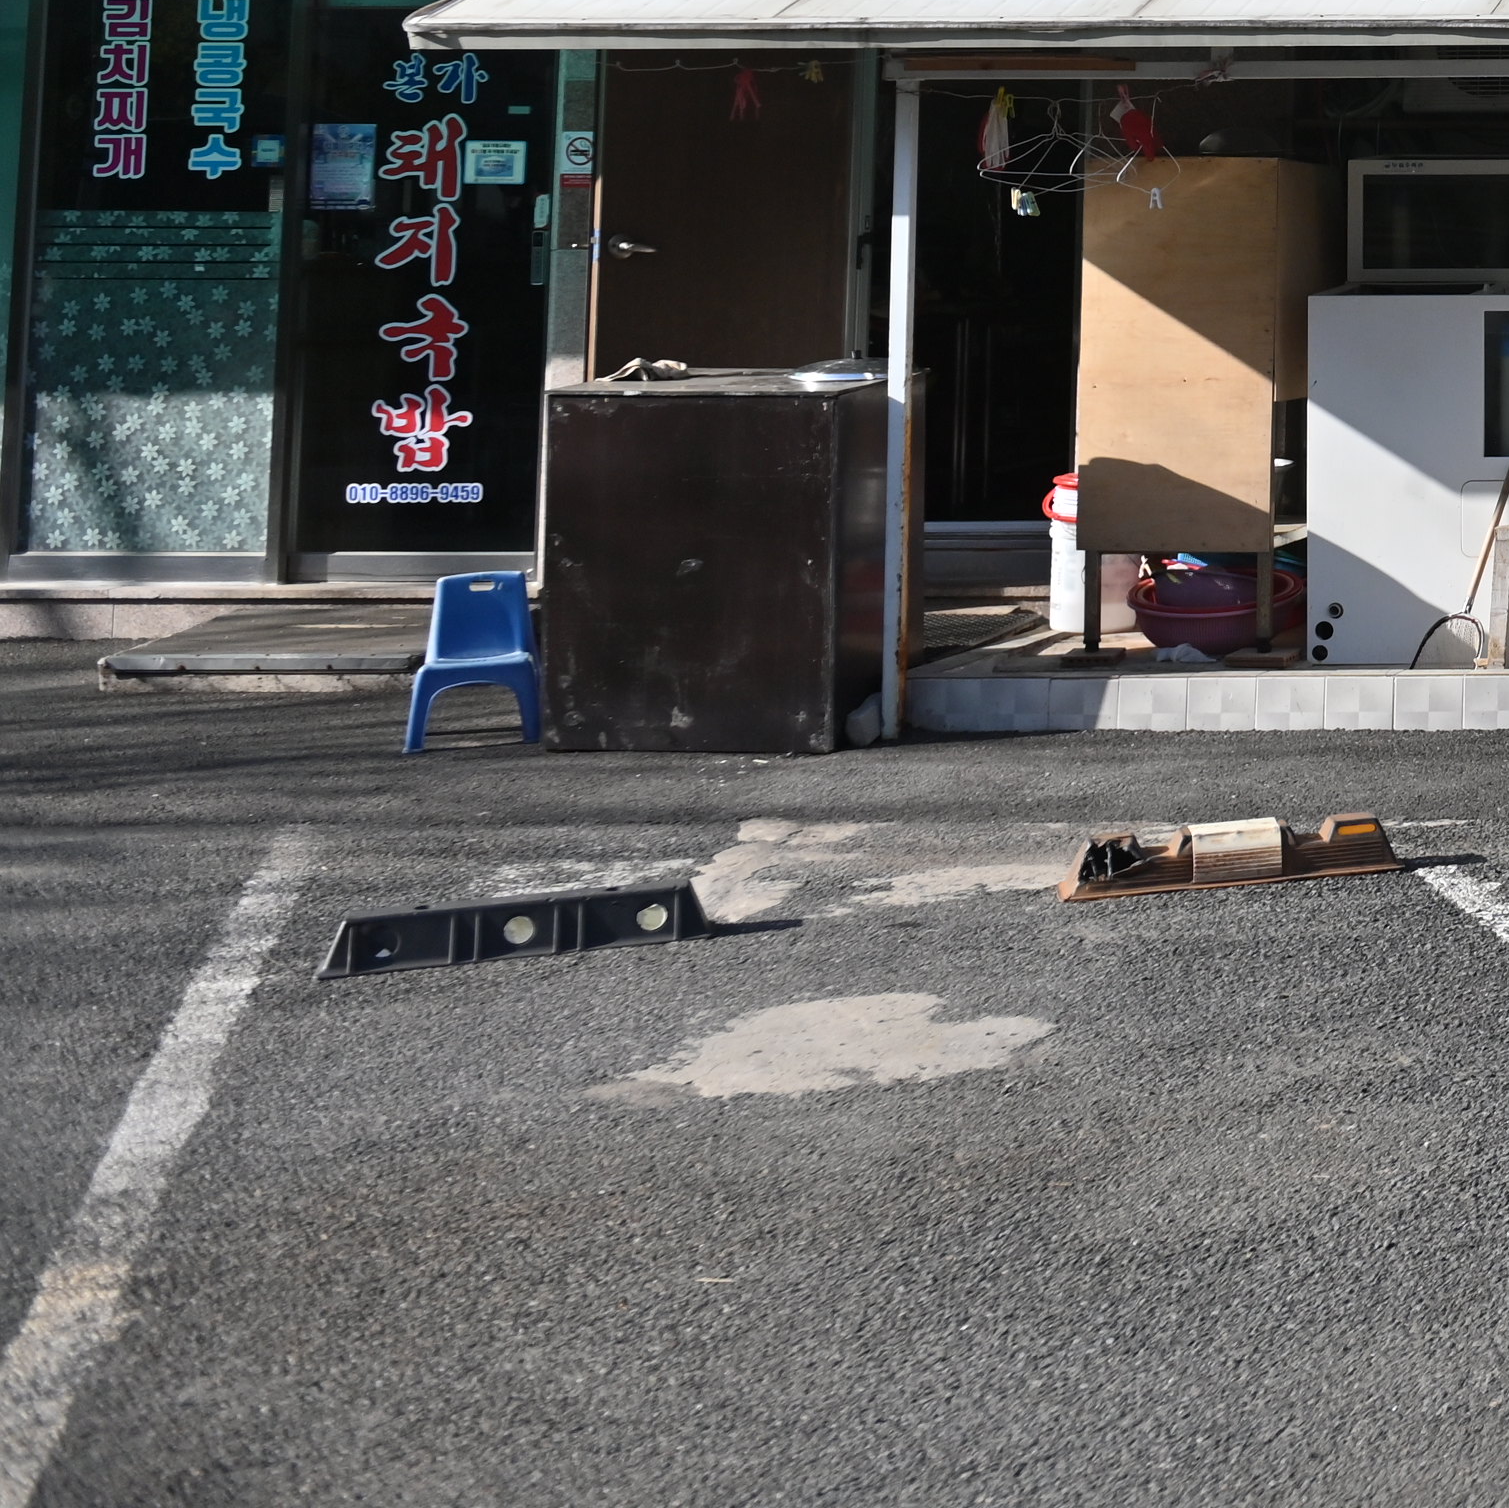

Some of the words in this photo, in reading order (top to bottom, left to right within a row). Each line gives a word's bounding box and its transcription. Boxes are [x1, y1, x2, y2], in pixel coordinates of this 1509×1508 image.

[383, 52, 489, 104] 본가
[372, 113, 473, 472] 돼지국밥
[346, 483, 483, 503] 010-8896-9459
